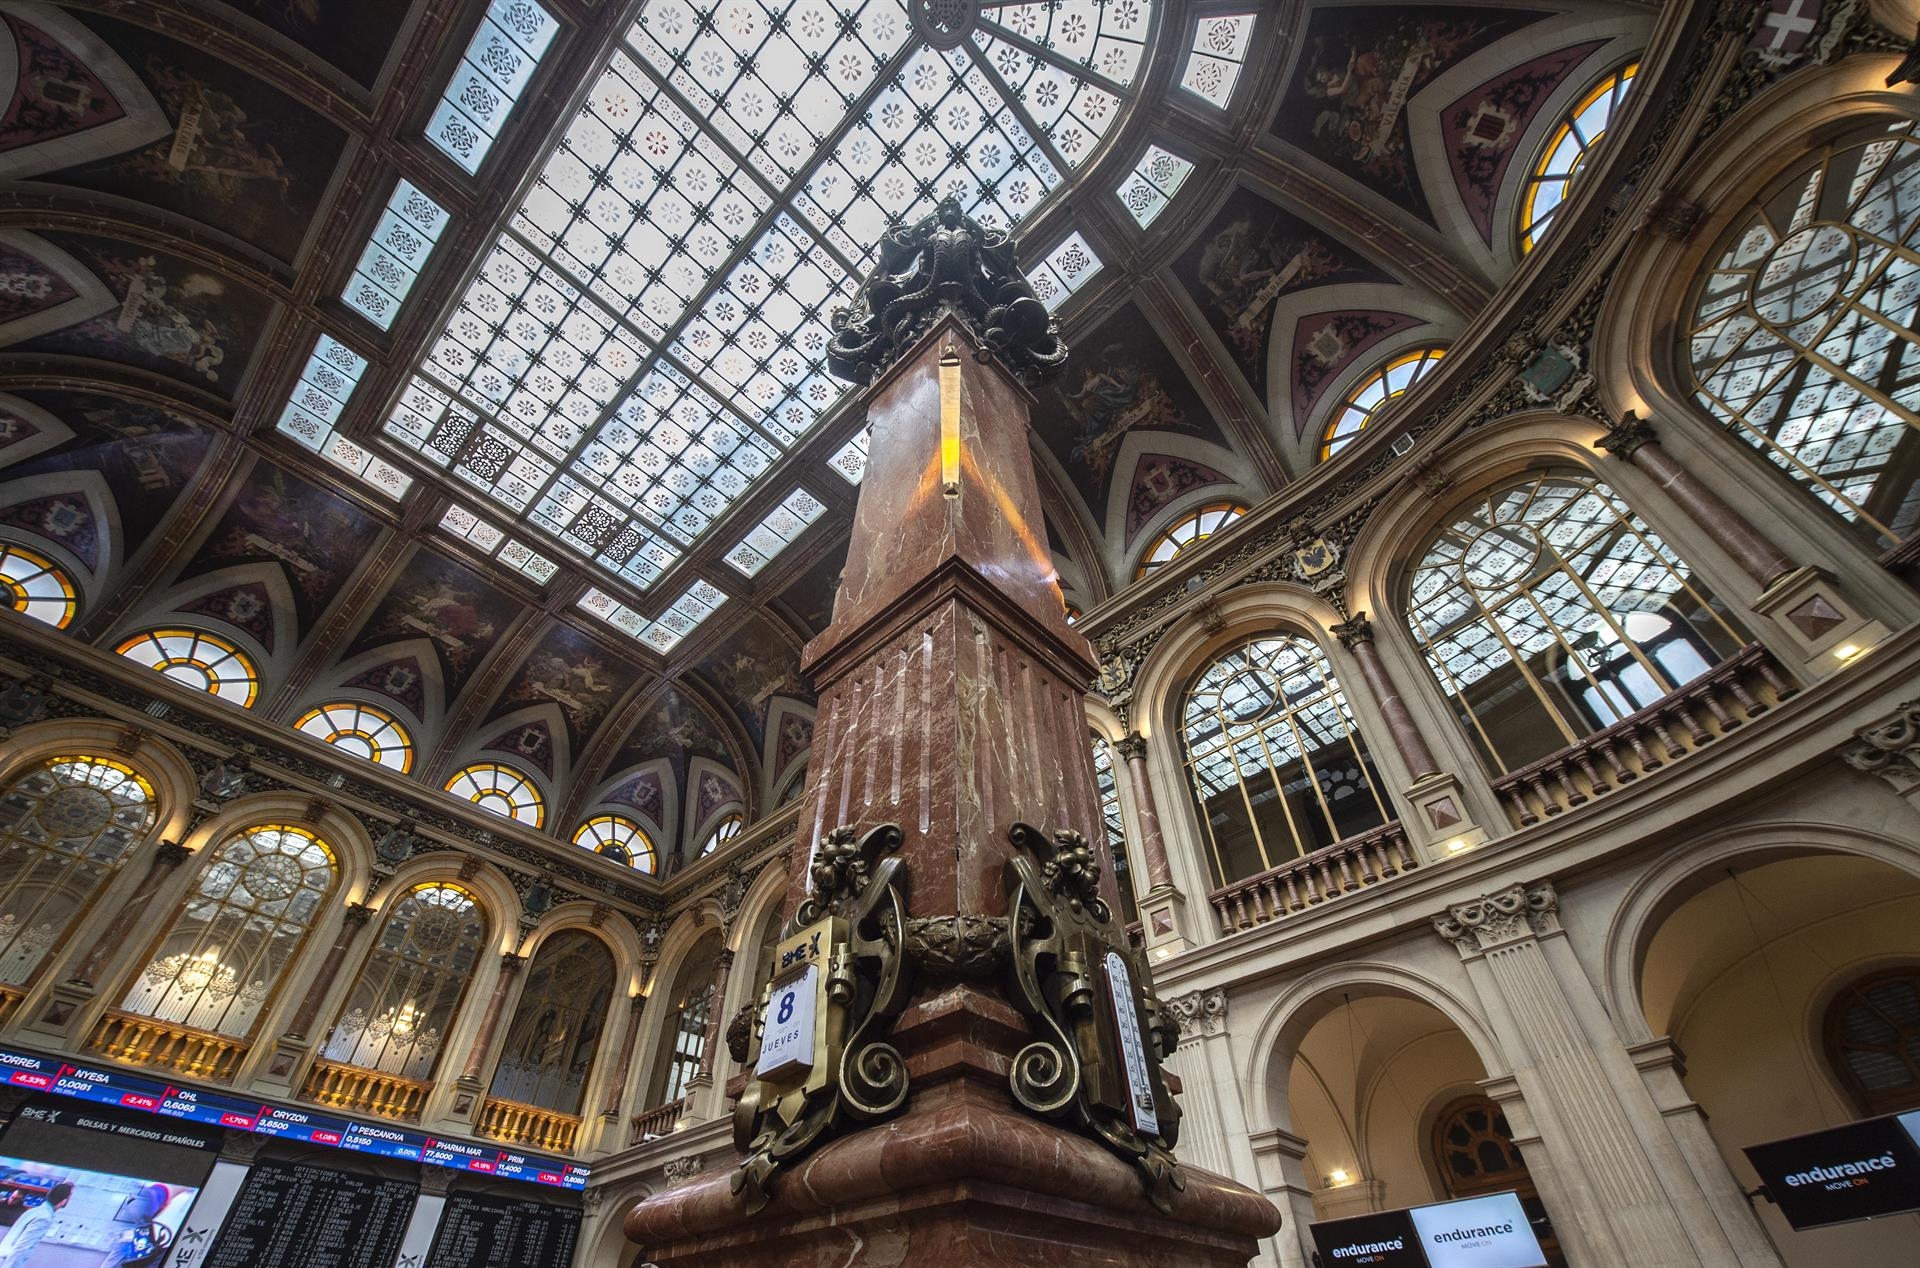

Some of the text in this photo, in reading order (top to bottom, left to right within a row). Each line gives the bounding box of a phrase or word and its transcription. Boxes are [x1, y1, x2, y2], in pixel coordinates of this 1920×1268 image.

[777, 991, 795, 1024] 8
[762, 1030, 799, 1054] JUEVES
[16, 1074, 46, 1086] -6,33%
[74, 1069, 110, 1084] NYESA
[58, 1078, 92, 1092] 0,0081
[126, 1096, 153, 1107] -2,41%
[178, 1090, 198, 1102] OHL
[21, 1107, 48, 1120] BME
[163, 1100, 196, 1113] 0,6065
[272, 1110, 309, 1123] ORYZON
[259, 1118, 289, 1130] 3,6500
[76, 1118, 108, 1131] BOLSAS
[118, 1126, 161, 1140] MERCADOS
[162, 1134, 206, 1148] ESPAÑOLES
[358, 1126, 404, 1142] PESCANOVA
[398, 1148, 417, 1156] 0,00%
[436, 1142, 482, 1156] PHARMA MAR
[508, 1155, 525, 1164] PRIM
[498, 1164, 522, 1174] 11,4000
[1785, 1156, 1896, 1187] endurance
[1825, 1178, 1870, 1192] MOVE ON
[1434, 1224, 1513, 1244] endurance
[1332, 1240, 1404, 1258] endurance
